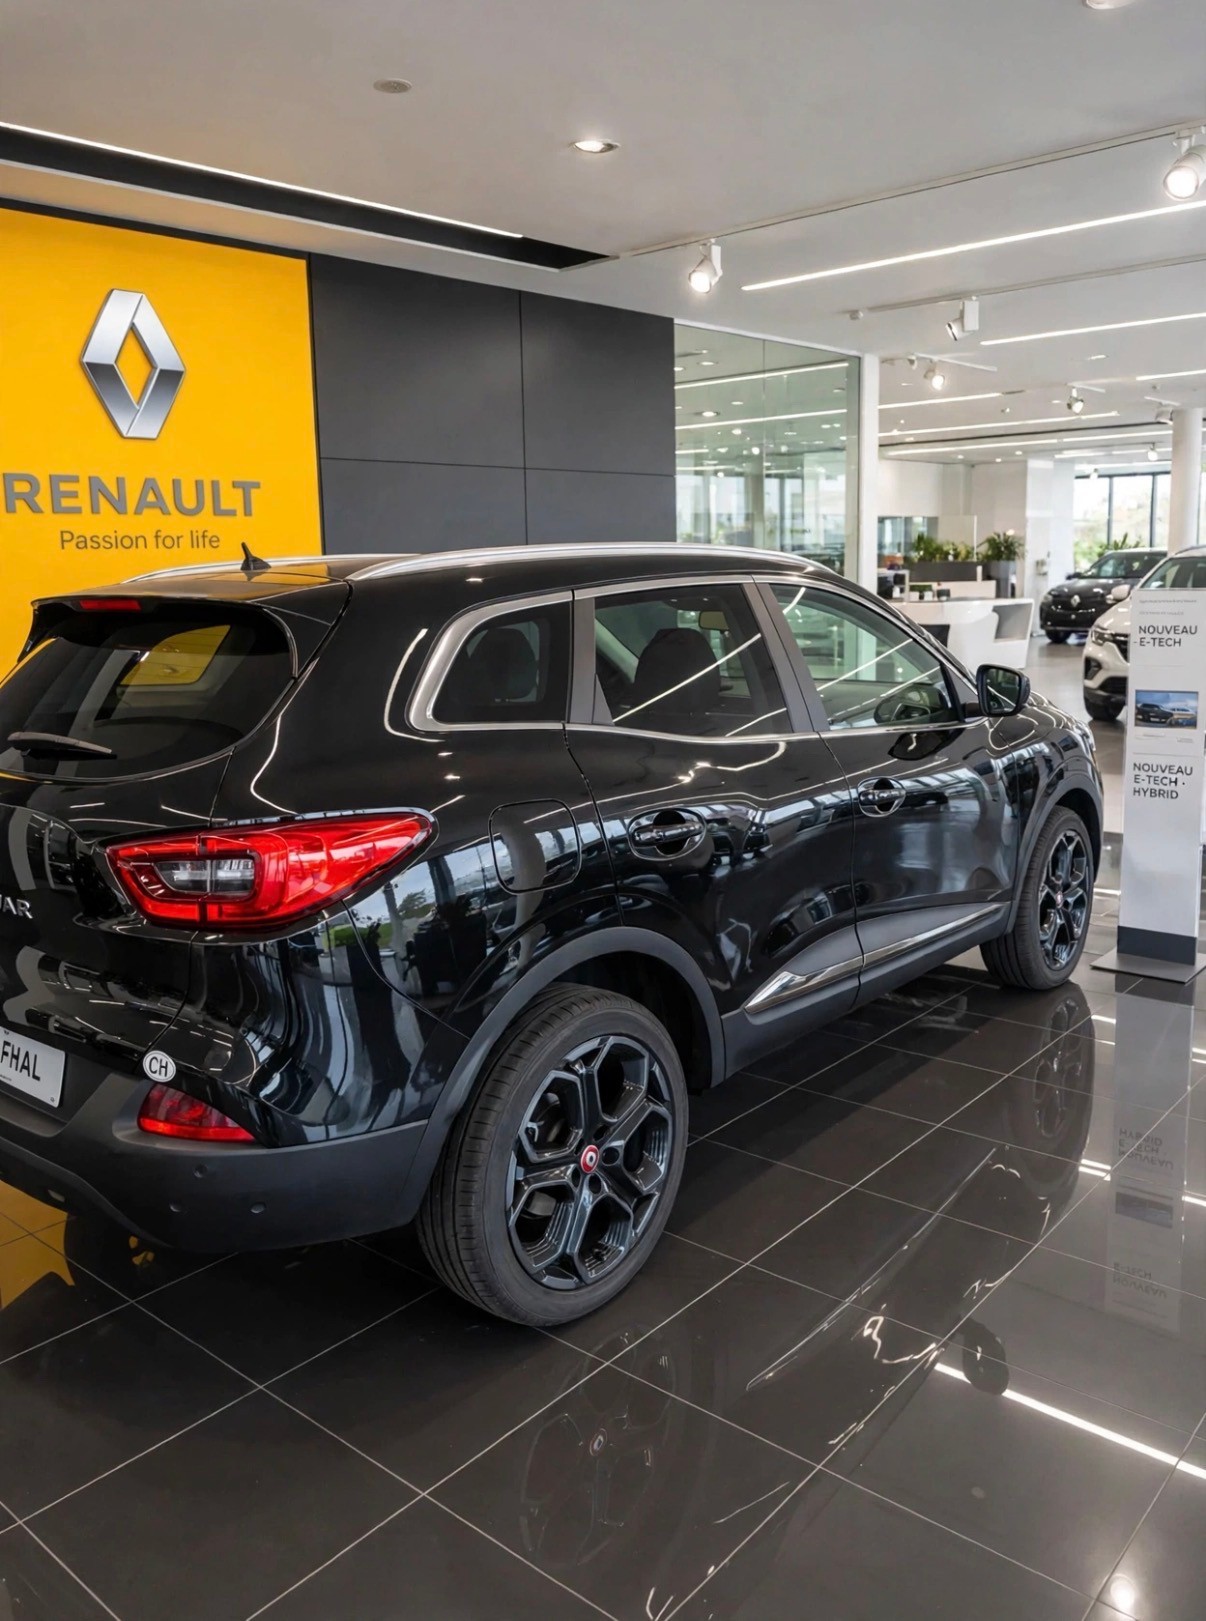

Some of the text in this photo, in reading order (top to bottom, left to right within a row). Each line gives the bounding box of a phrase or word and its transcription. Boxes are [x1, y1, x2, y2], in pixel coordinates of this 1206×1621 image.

[3, 472, 261, 517] RENAULT
[60, 529, 220, 550] Passion for life
[1138, 625, 1198, 635] NOUVEAU
[1133, 762, 1193, 776] NOUVEAU
[1132, 787, 1179, 800] HYBRID
[0, 894, 33, 919] AR
[0, 1040, 41, 1081] FHAL
[149, 1056, 169, 1078] CH
